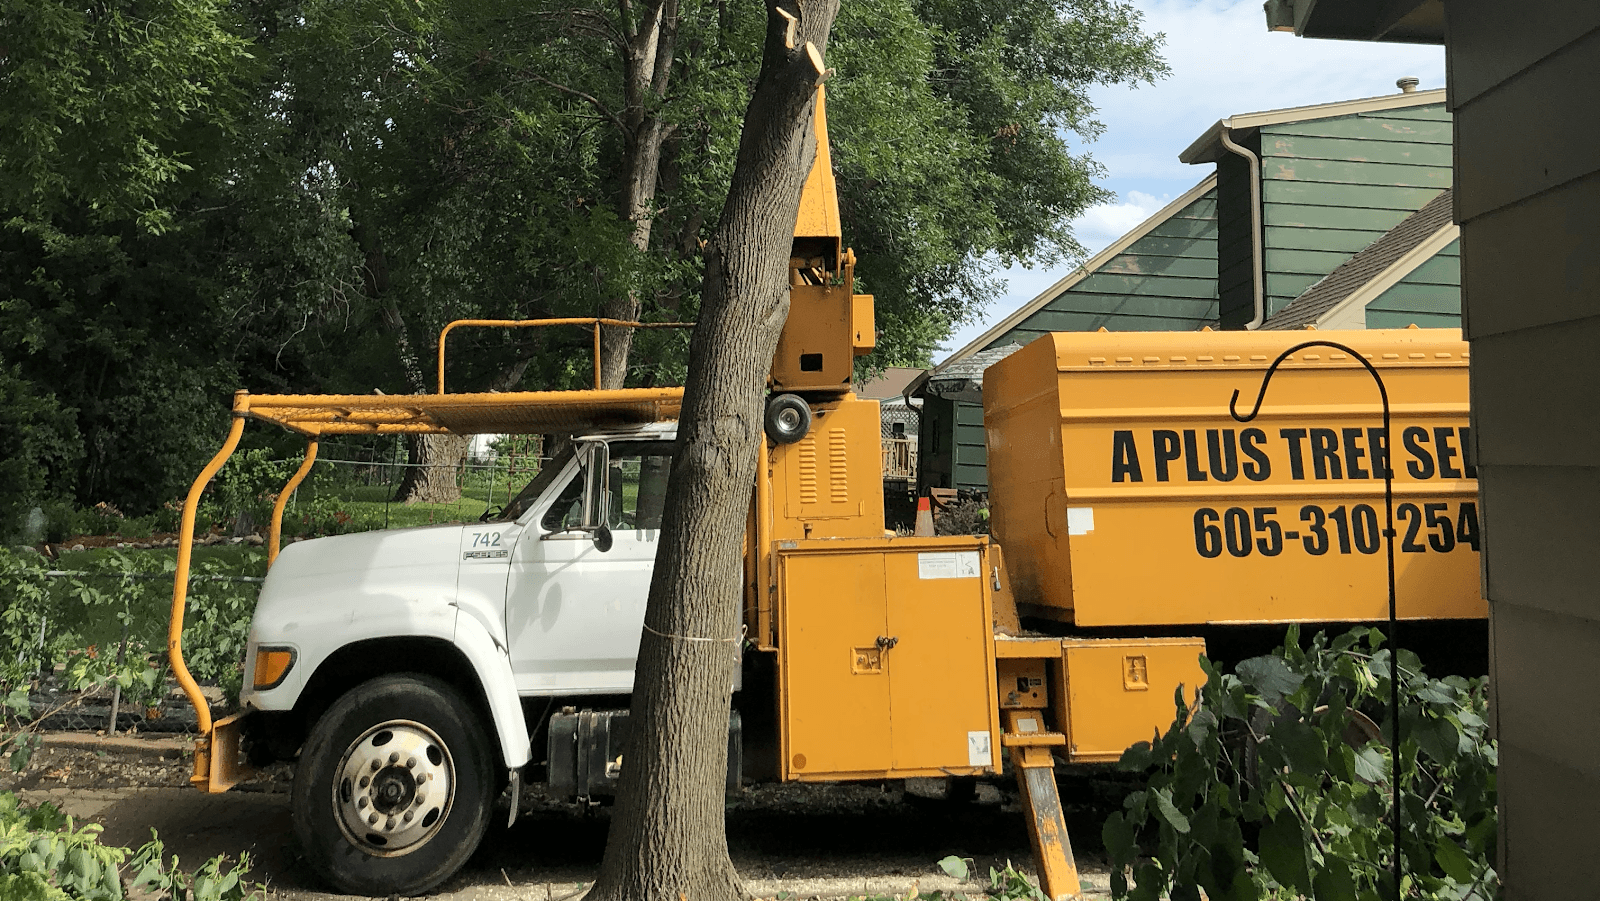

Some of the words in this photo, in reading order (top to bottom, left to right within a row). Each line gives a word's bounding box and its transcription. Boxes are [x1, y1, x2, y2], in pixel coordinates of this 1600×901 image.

[1111, 430, 1142, 482] A
[1152, 427, 1271, 482] PLUS
[1280, 427, 1394, 480] TREE
[472, 532, 501, 547] 742
[1193, 502, 1480, 558] 605-310-254
